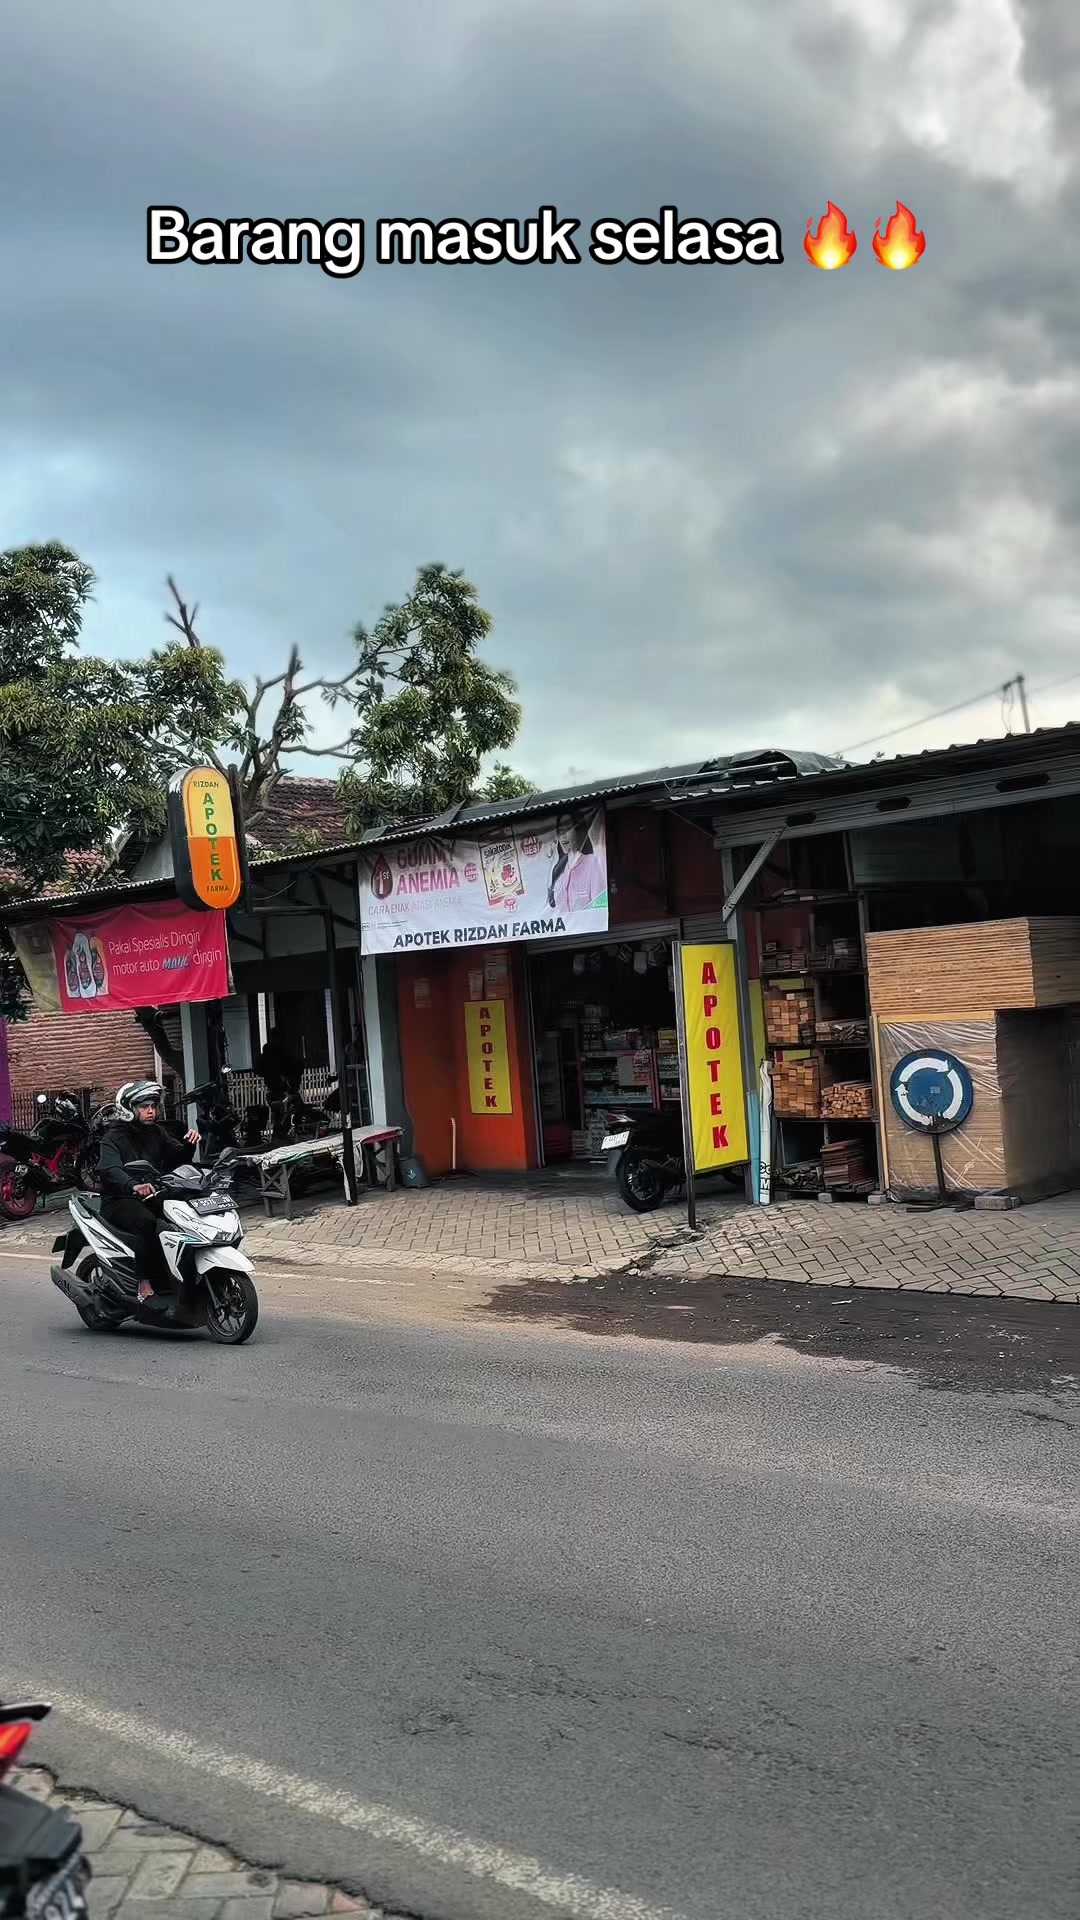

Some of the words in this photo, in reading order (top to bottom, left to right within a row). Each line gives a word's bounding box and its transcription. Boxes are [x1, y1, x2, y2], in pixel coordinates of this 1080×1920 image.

[203, 793, 223, 881] APOTEK
[397, 839, 456, 869] GUMMY
[206, 885, 229, 893] FARMA
[396, 867, 461, 895] ANEMIA
[368, 904, 389, 916] CARA
[391, 902, 410, 914] ENAK
[108, 940, 132, 955] Pakai
[132, 933, 169, 956] Spesialis
[170, 929, 200, 949] Dingin
[393, 929, 450, 948] APOTEK
[454, 923, 508, 942] RIZDAN
[512, 917, 566, 937] FARMA
[112, 961, 138, 976] motor
[140, 959, 160, 973] auto
[192, 948, 222, 967] dingin
[479, 1007, 497, 1107] APOTEK
[702, 961, 729, 1150] APOTEK
